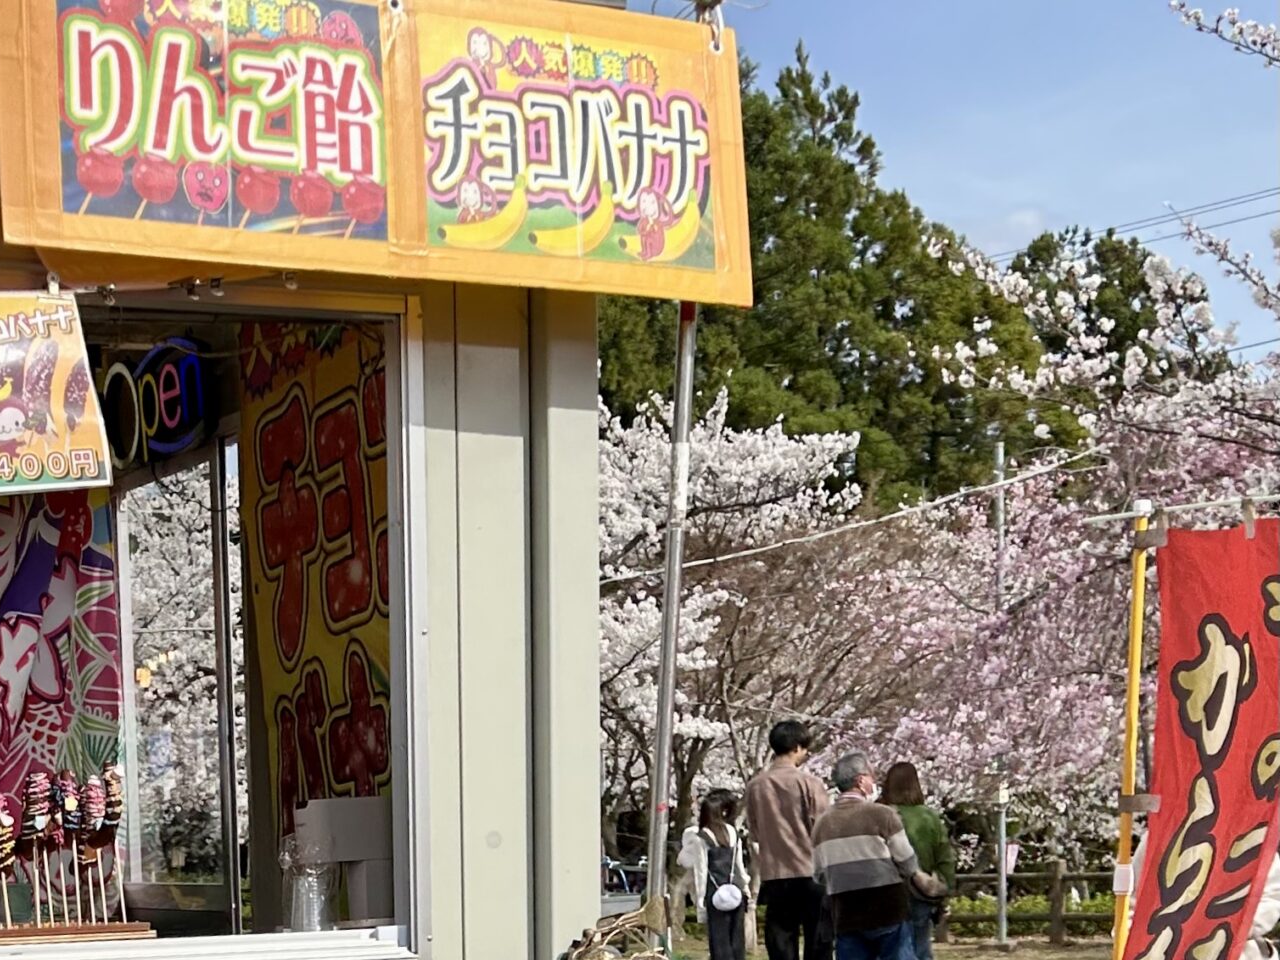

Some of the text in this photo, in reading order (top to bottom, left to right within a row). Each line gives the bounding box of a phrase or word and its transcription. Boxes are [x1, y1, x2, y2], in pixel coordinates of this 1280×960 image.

[68, 20, 383, 185] りんご飴
[513, 41, 649, 85] 人気爆発!!
[429, 73, 705, 209] チョコバナナ
[103, 353, 204, 470] Open
